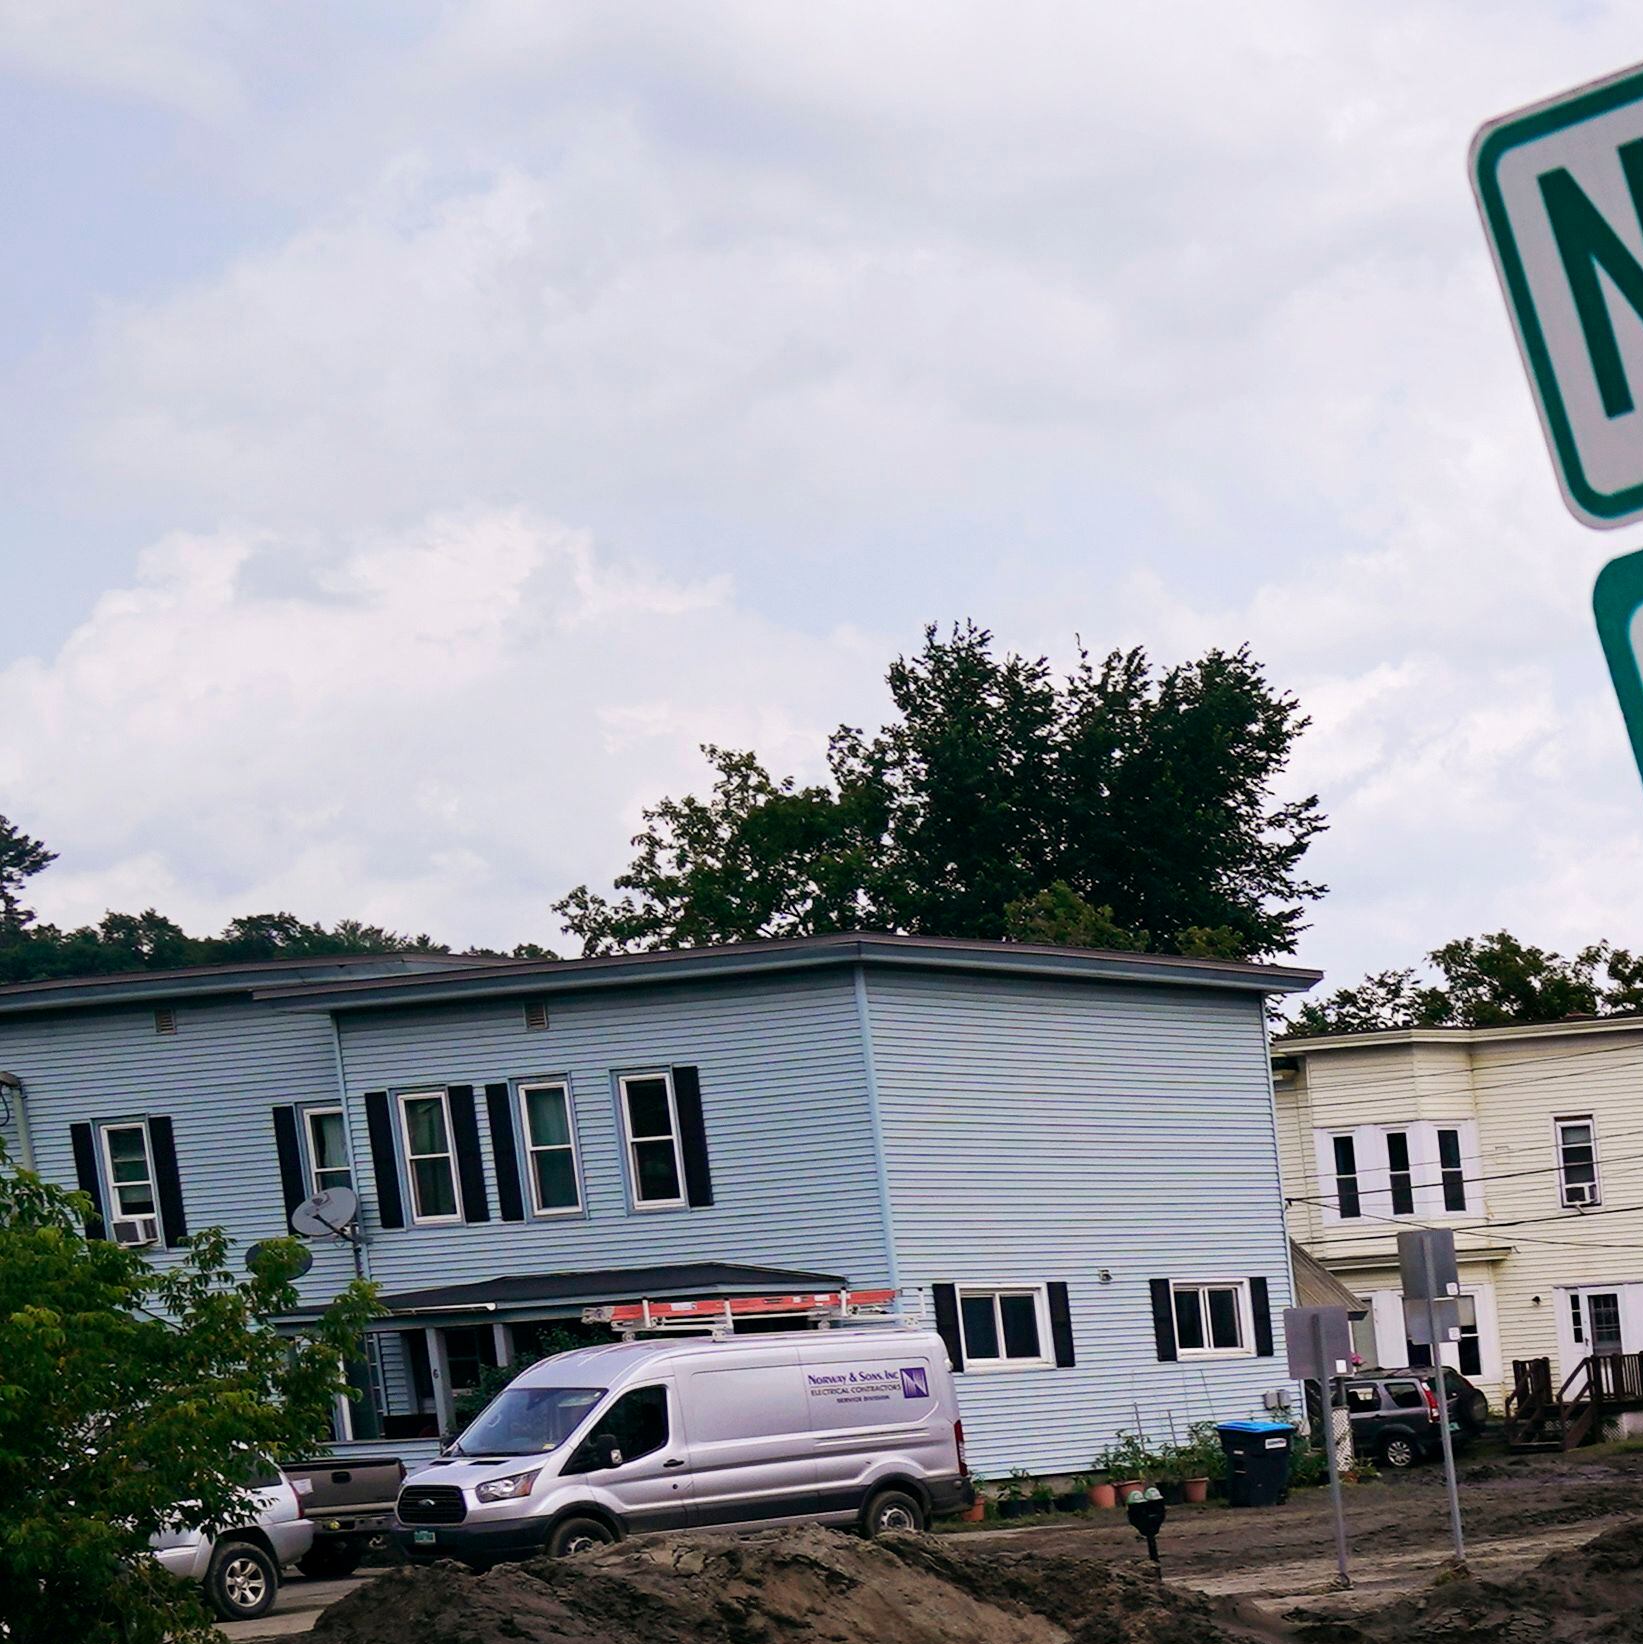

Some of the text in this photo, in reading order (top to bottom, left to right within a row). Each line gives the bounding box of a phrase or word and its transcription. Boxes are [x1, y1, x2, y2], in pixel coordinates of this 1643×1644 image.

[433, 1369, 439, 1379] 6
[849, 1372, 857, 1382] &
[811, 1384, 901, 1396] ELECTRICAL CONTRACTORS
